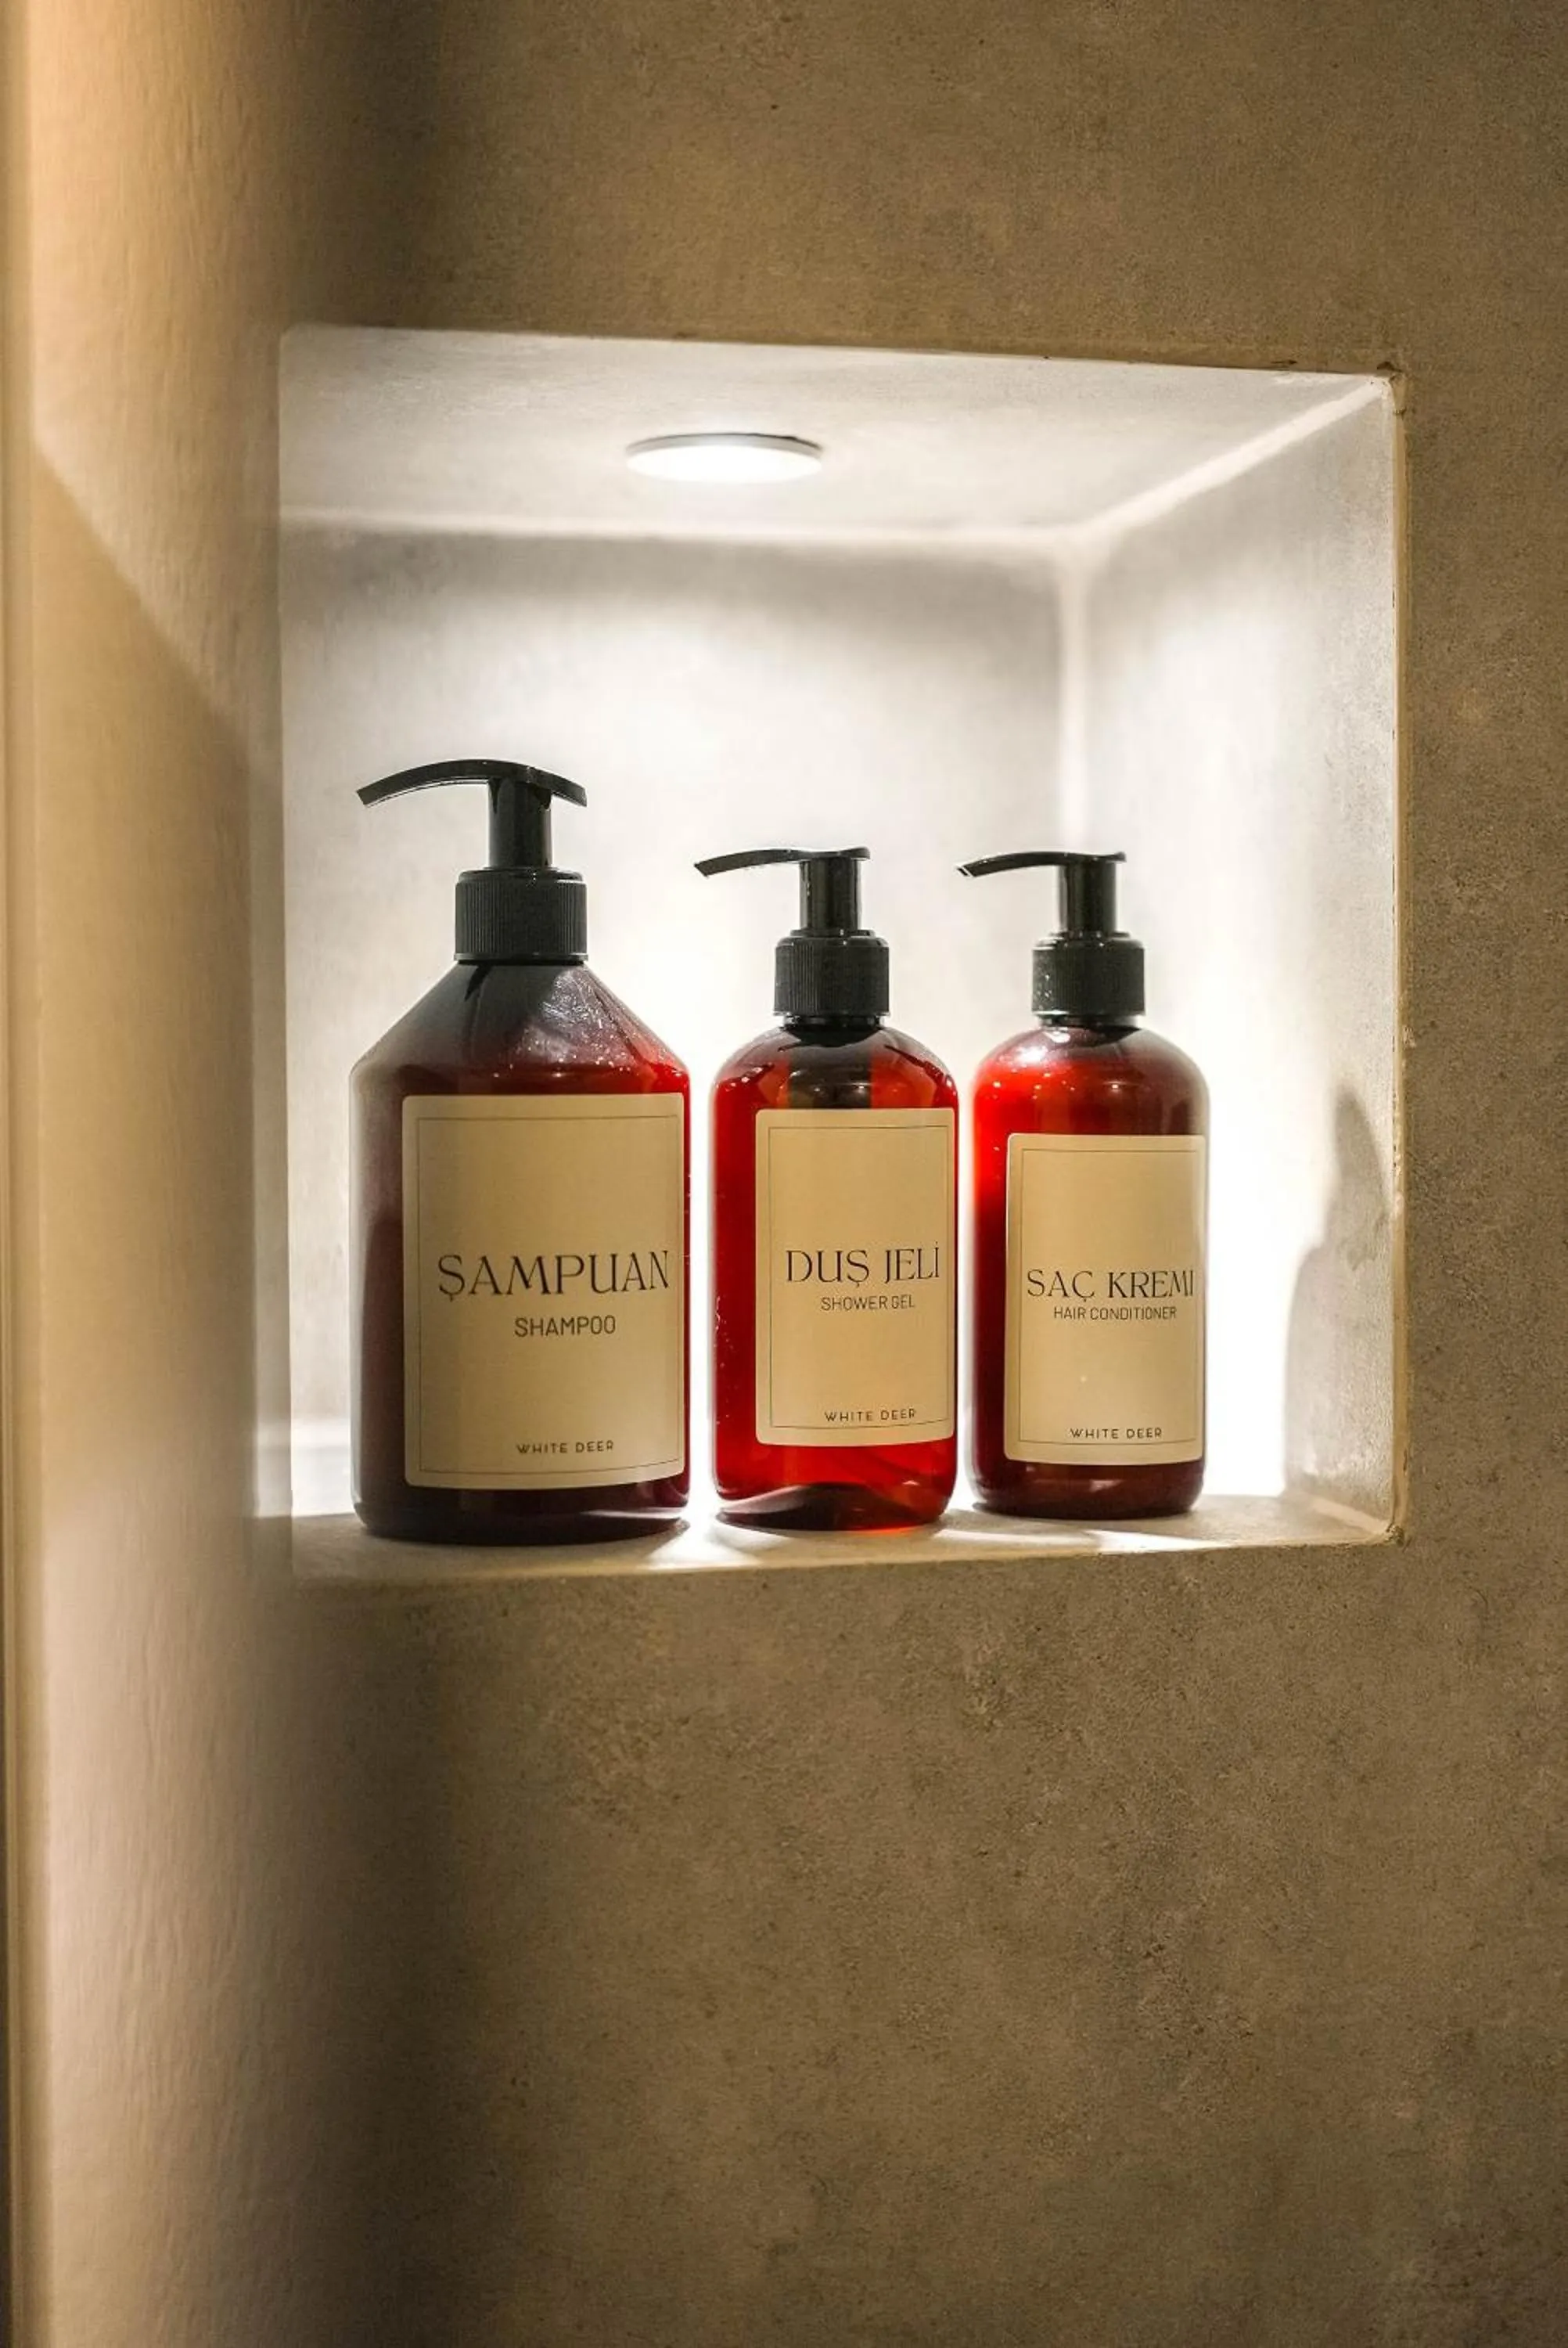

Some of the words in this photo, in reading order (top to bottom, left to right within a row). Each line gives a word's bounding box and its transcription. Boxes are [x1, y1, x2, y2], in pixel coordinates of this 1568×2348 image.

[437, 1250, 670, 1301] ŞAMPUAN
[786, 1250, 870, 1287] DUŞ
[1027, 1269, 1095, 1302] SAÇ
[821, 1295, 890, 1311] SHOWER
[890, 1295, 915, 1309] GEL
[1054, 1307, 1087, 1320] HAIR
[1090, 1307, 1178, 1320] CONDITIONER
[514, 1315, 616, 1338] SHAMPOO
[825, 1411, 873, 1422] WHITE
[880, 1409, 915, 1420] DEER
[1070, 1428, 1119, 1439] WHITE
[1126, 1428, 1162, 1439] DEER
[516, 1443, 568, 1455] WHITE
[575, 1440, 614, 1453] DEER
